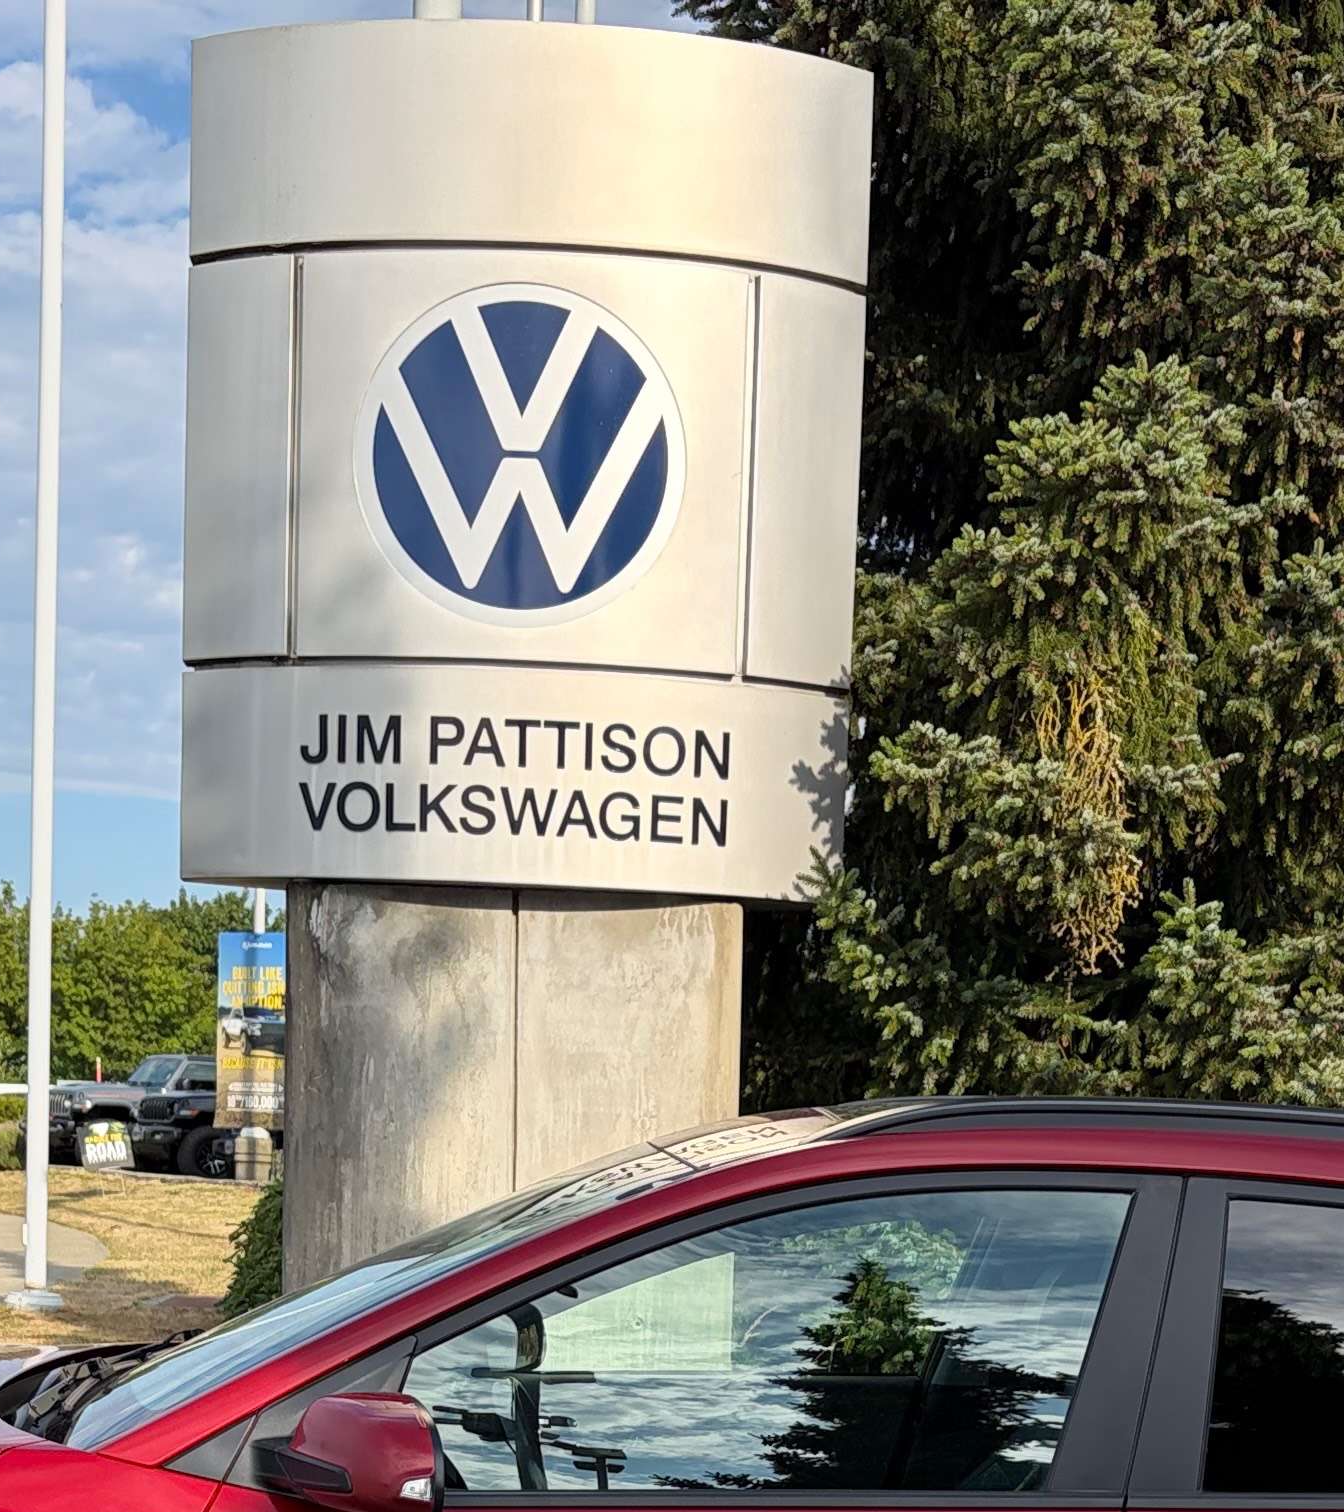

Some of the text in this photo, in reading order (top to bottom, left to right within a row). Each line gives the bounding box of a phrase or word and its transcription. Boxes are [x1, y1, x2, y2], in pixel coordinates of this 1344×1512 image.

[300, 713, 731, 781] JIM PATTISON
[298, 781, 728, 848] VOLKSWAGEN
[85, 1141, 128, 1164] ROAD
